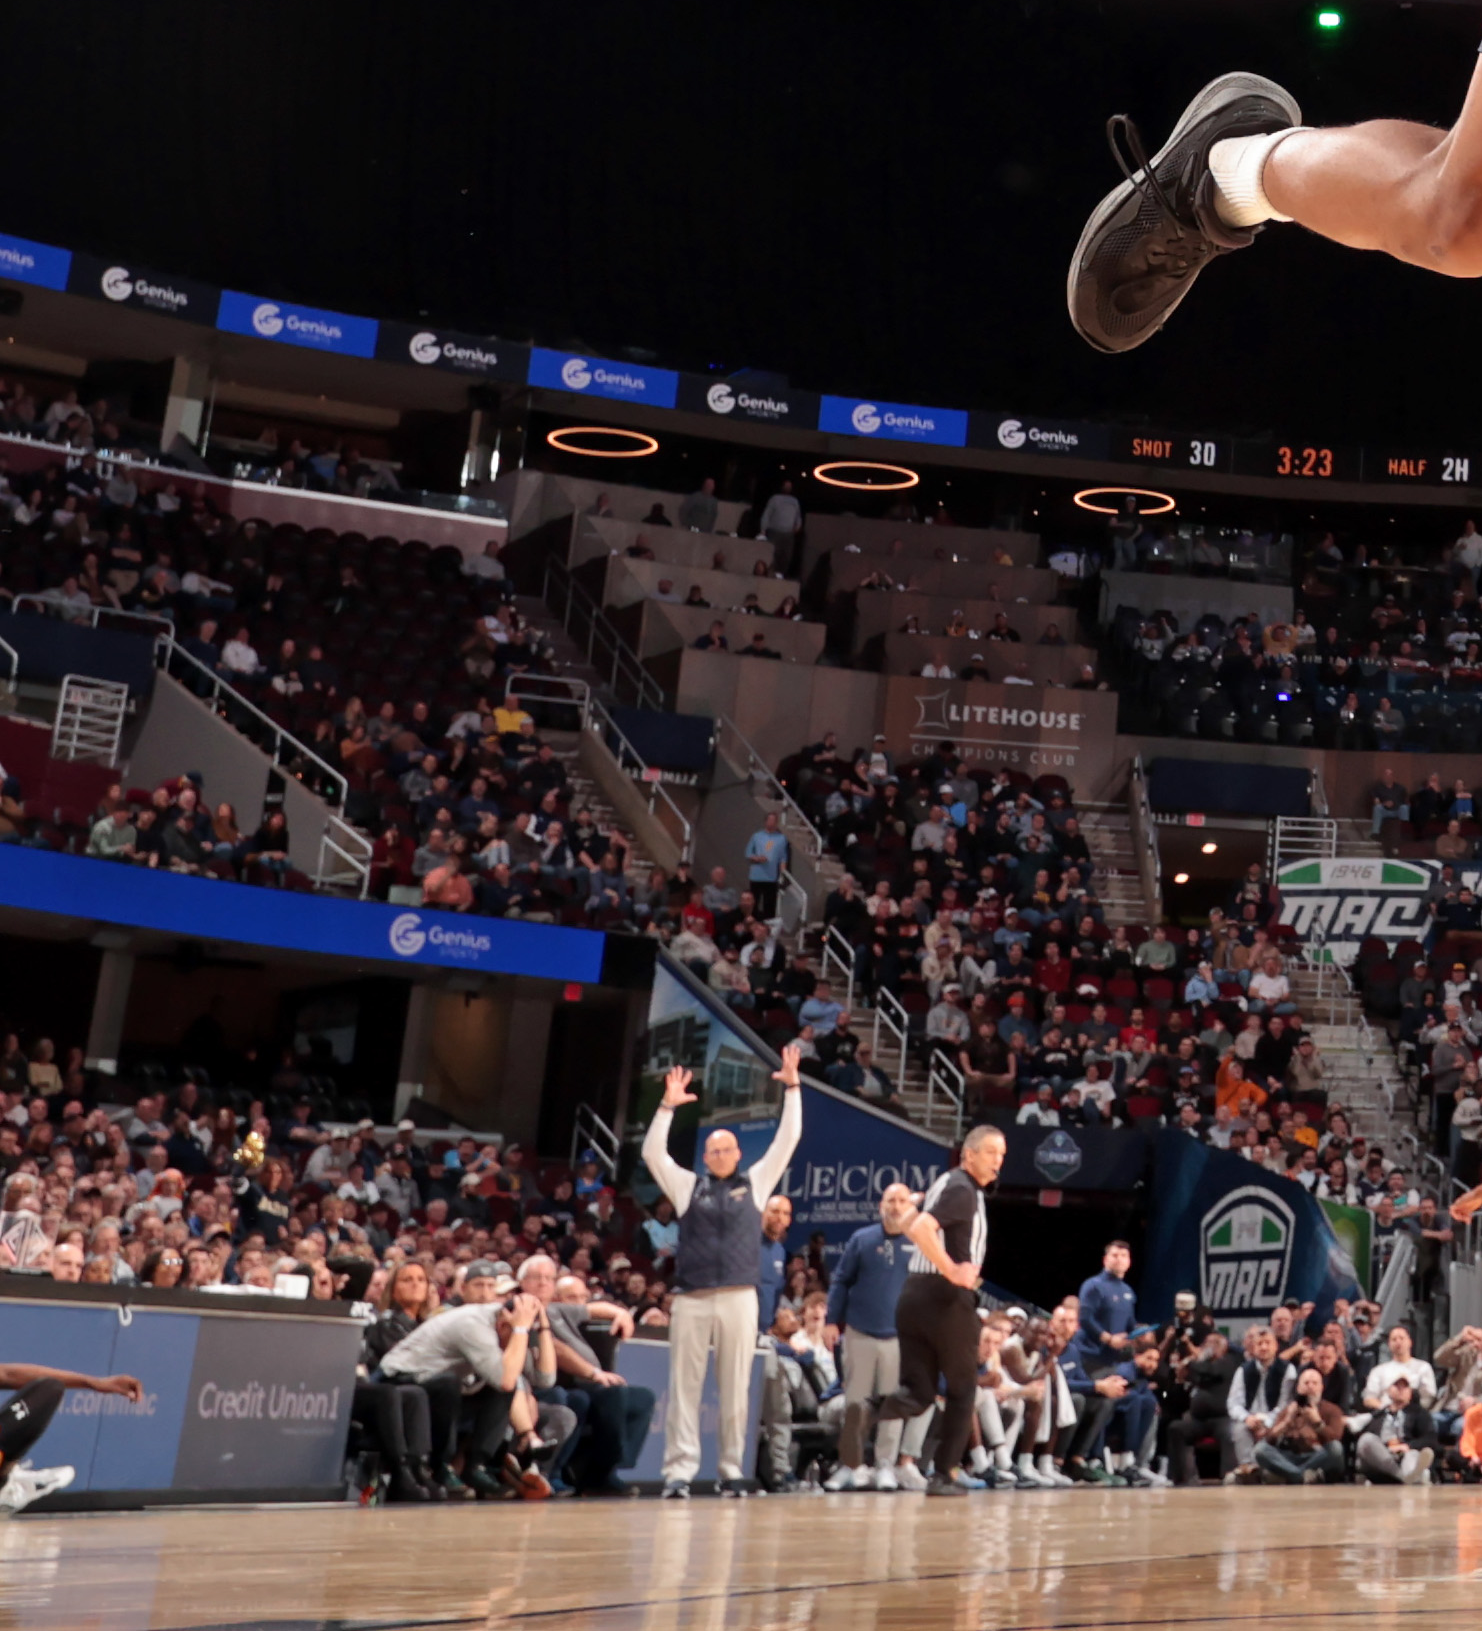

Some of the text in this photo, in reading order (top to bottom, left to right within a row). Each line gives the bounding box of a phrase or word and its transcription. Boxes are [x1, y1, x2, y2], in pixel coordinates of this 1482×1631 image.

[0, 247, 34, 268] nius
[135, 278, 188, 308] Genius
[286, 314, 342, 339] Genius
[443, 342, 498, 367] Genius
[593, 368, 645, 391] Genius
[737, 392, 789, 415] Genius
[883, 411, 935, 433] Genius
[1028, 427, 1079, 448] Genius
[1131, 438, 1216, 466] SHOT 30
[1276, 446, 1334, 478] 3:23
[1388, 458, 1469, 482] HALF 2H
[949, 704, 1081, 731] LITEHOUSE
[911, 743, 1075, 767] CHMPIONS CLUB
[1330, 864, 1373, 880] 1946
[1279, 896, 1422, 936] MAC
[428, 925, 491, 952] Genius
[1202, 1258, 1282, 1310] MAC
[198, 1381, 340, 1420] Credit Union1
